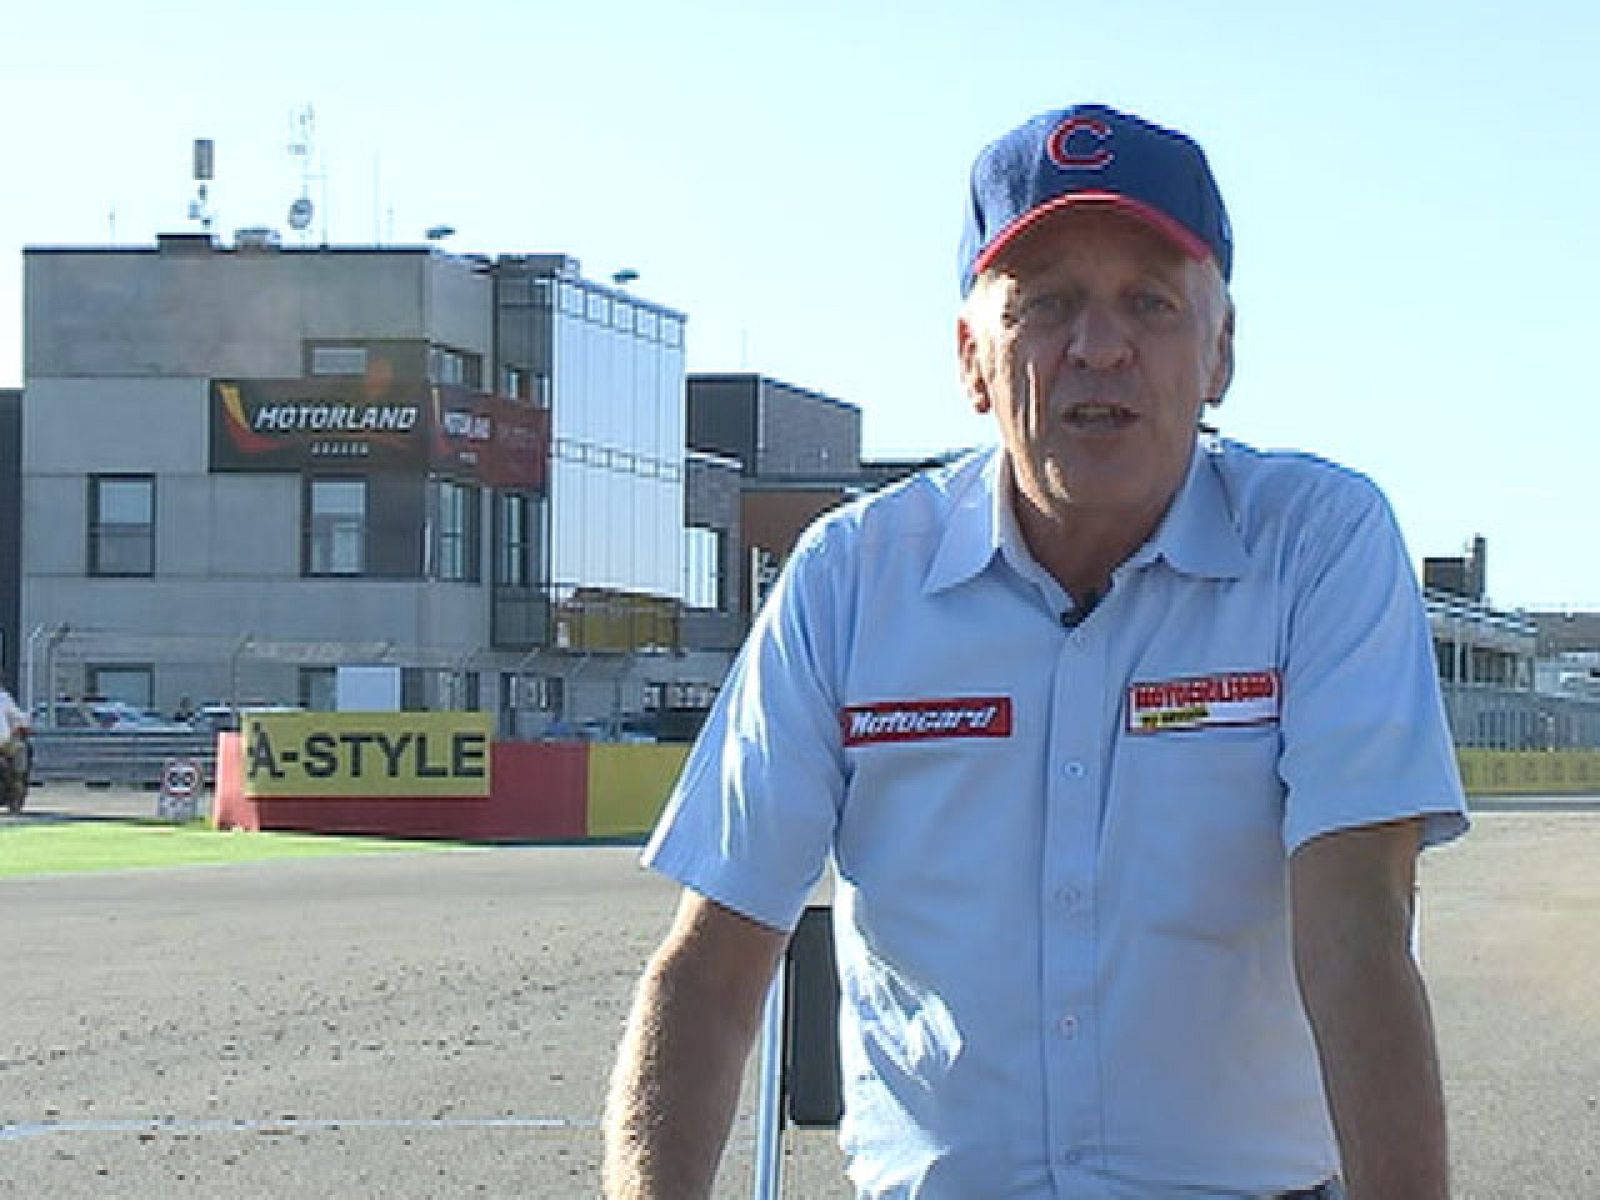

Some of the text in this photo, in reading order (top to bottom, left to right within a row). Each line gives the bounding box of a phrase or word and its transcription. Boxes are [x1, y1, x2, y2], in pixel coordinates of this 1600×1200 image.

[1047, 117, 1113, 171] C
[253, 406, 418, 430] MOTORLAND
[248, 720, 487, 778] A-STYLE
